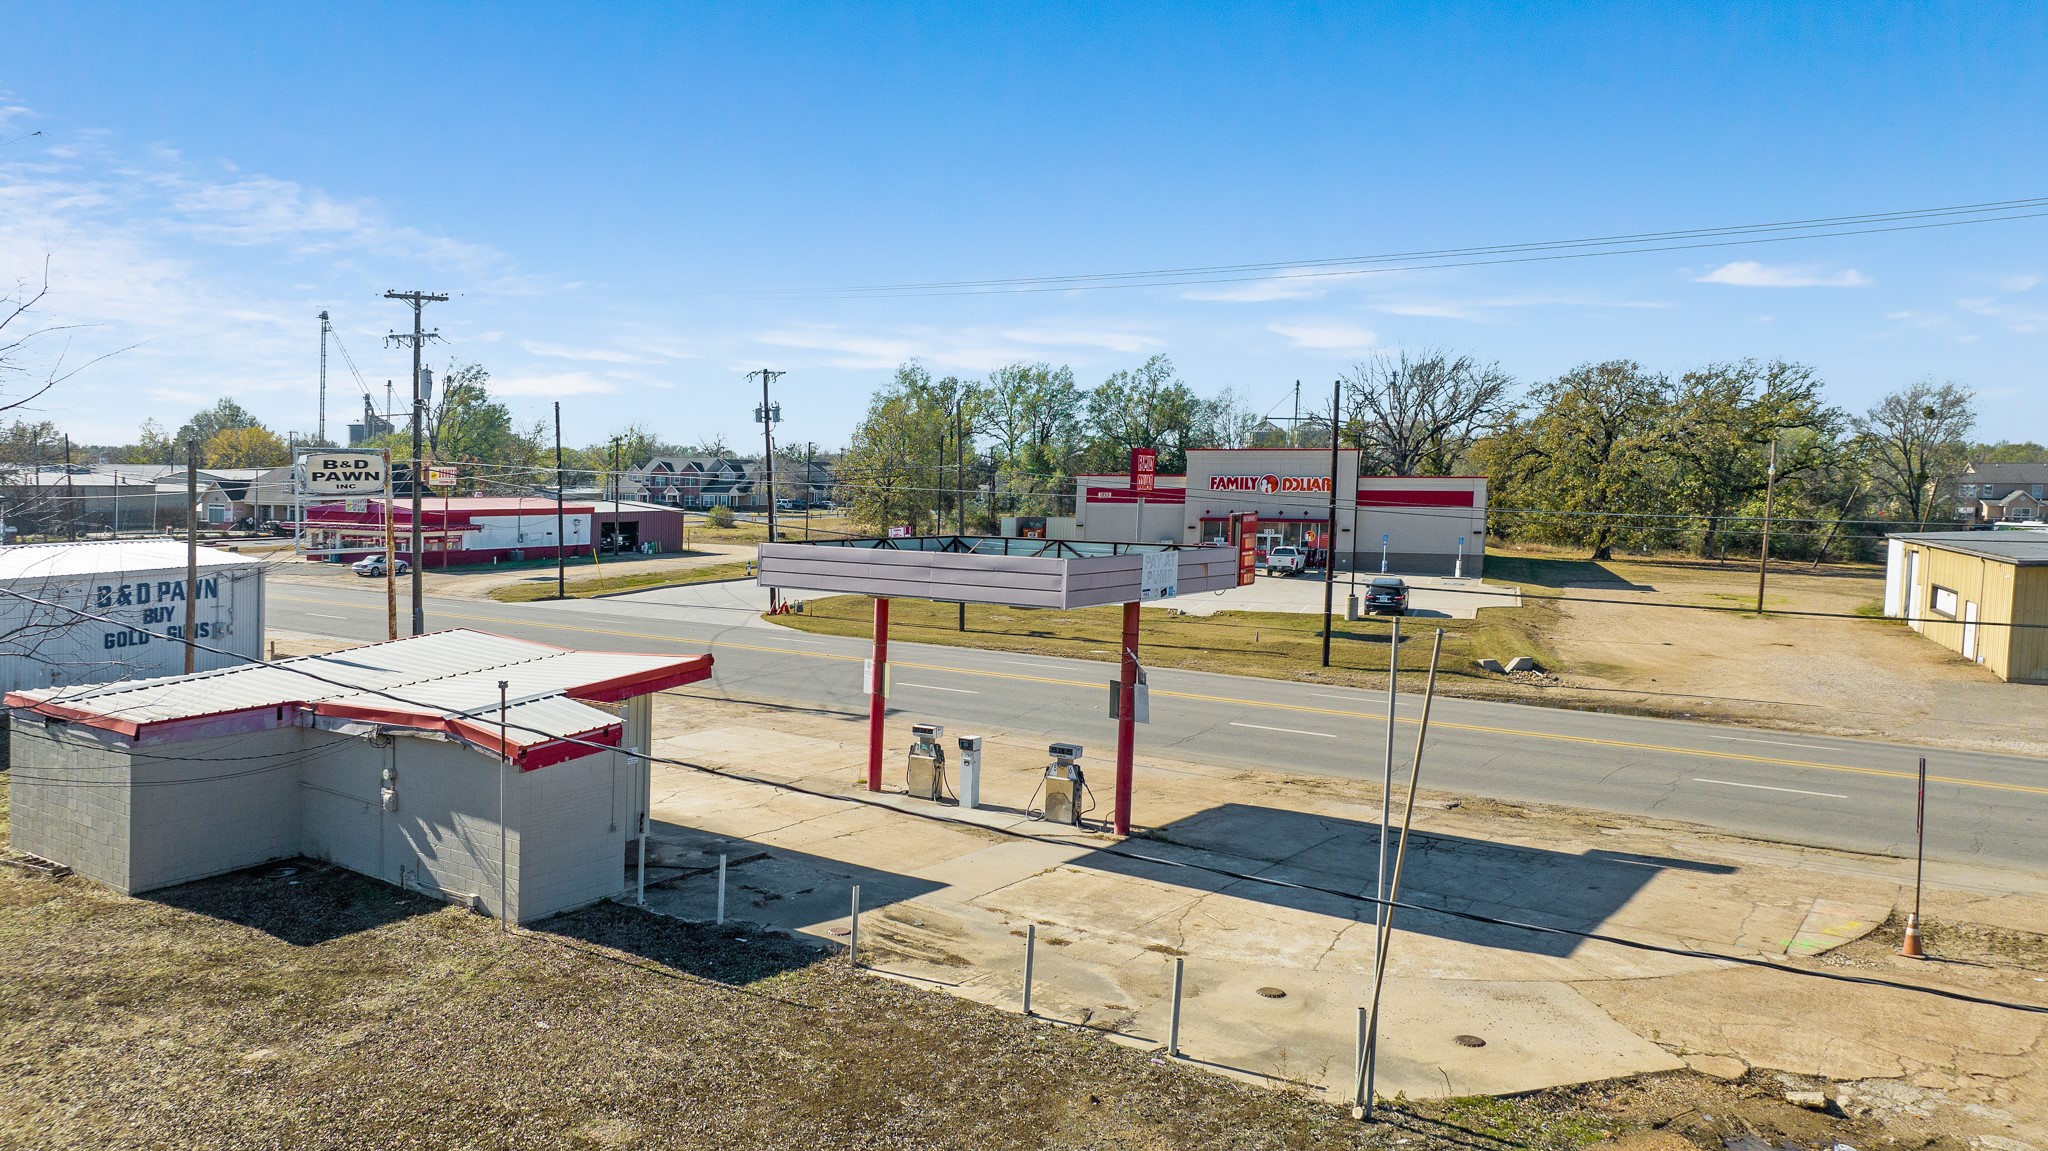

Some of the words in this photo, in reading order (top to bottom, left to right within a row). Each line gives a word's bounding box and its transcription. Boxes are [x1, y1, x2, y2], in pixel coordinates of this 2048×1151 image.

[323, 459, 369, 469] B&D
[312, 471, 380, 481] PAWN
[1210, 476, 1260, 491] FAMILY
[1281, 476, 1331, 492] DOLLAR
[1145, 553, 1163, 569] PAY
[1147, 568, 1174, 585] PUMP
[143, 605, 175, 624] BUY
[104, 628, 150, 650] GOLD
